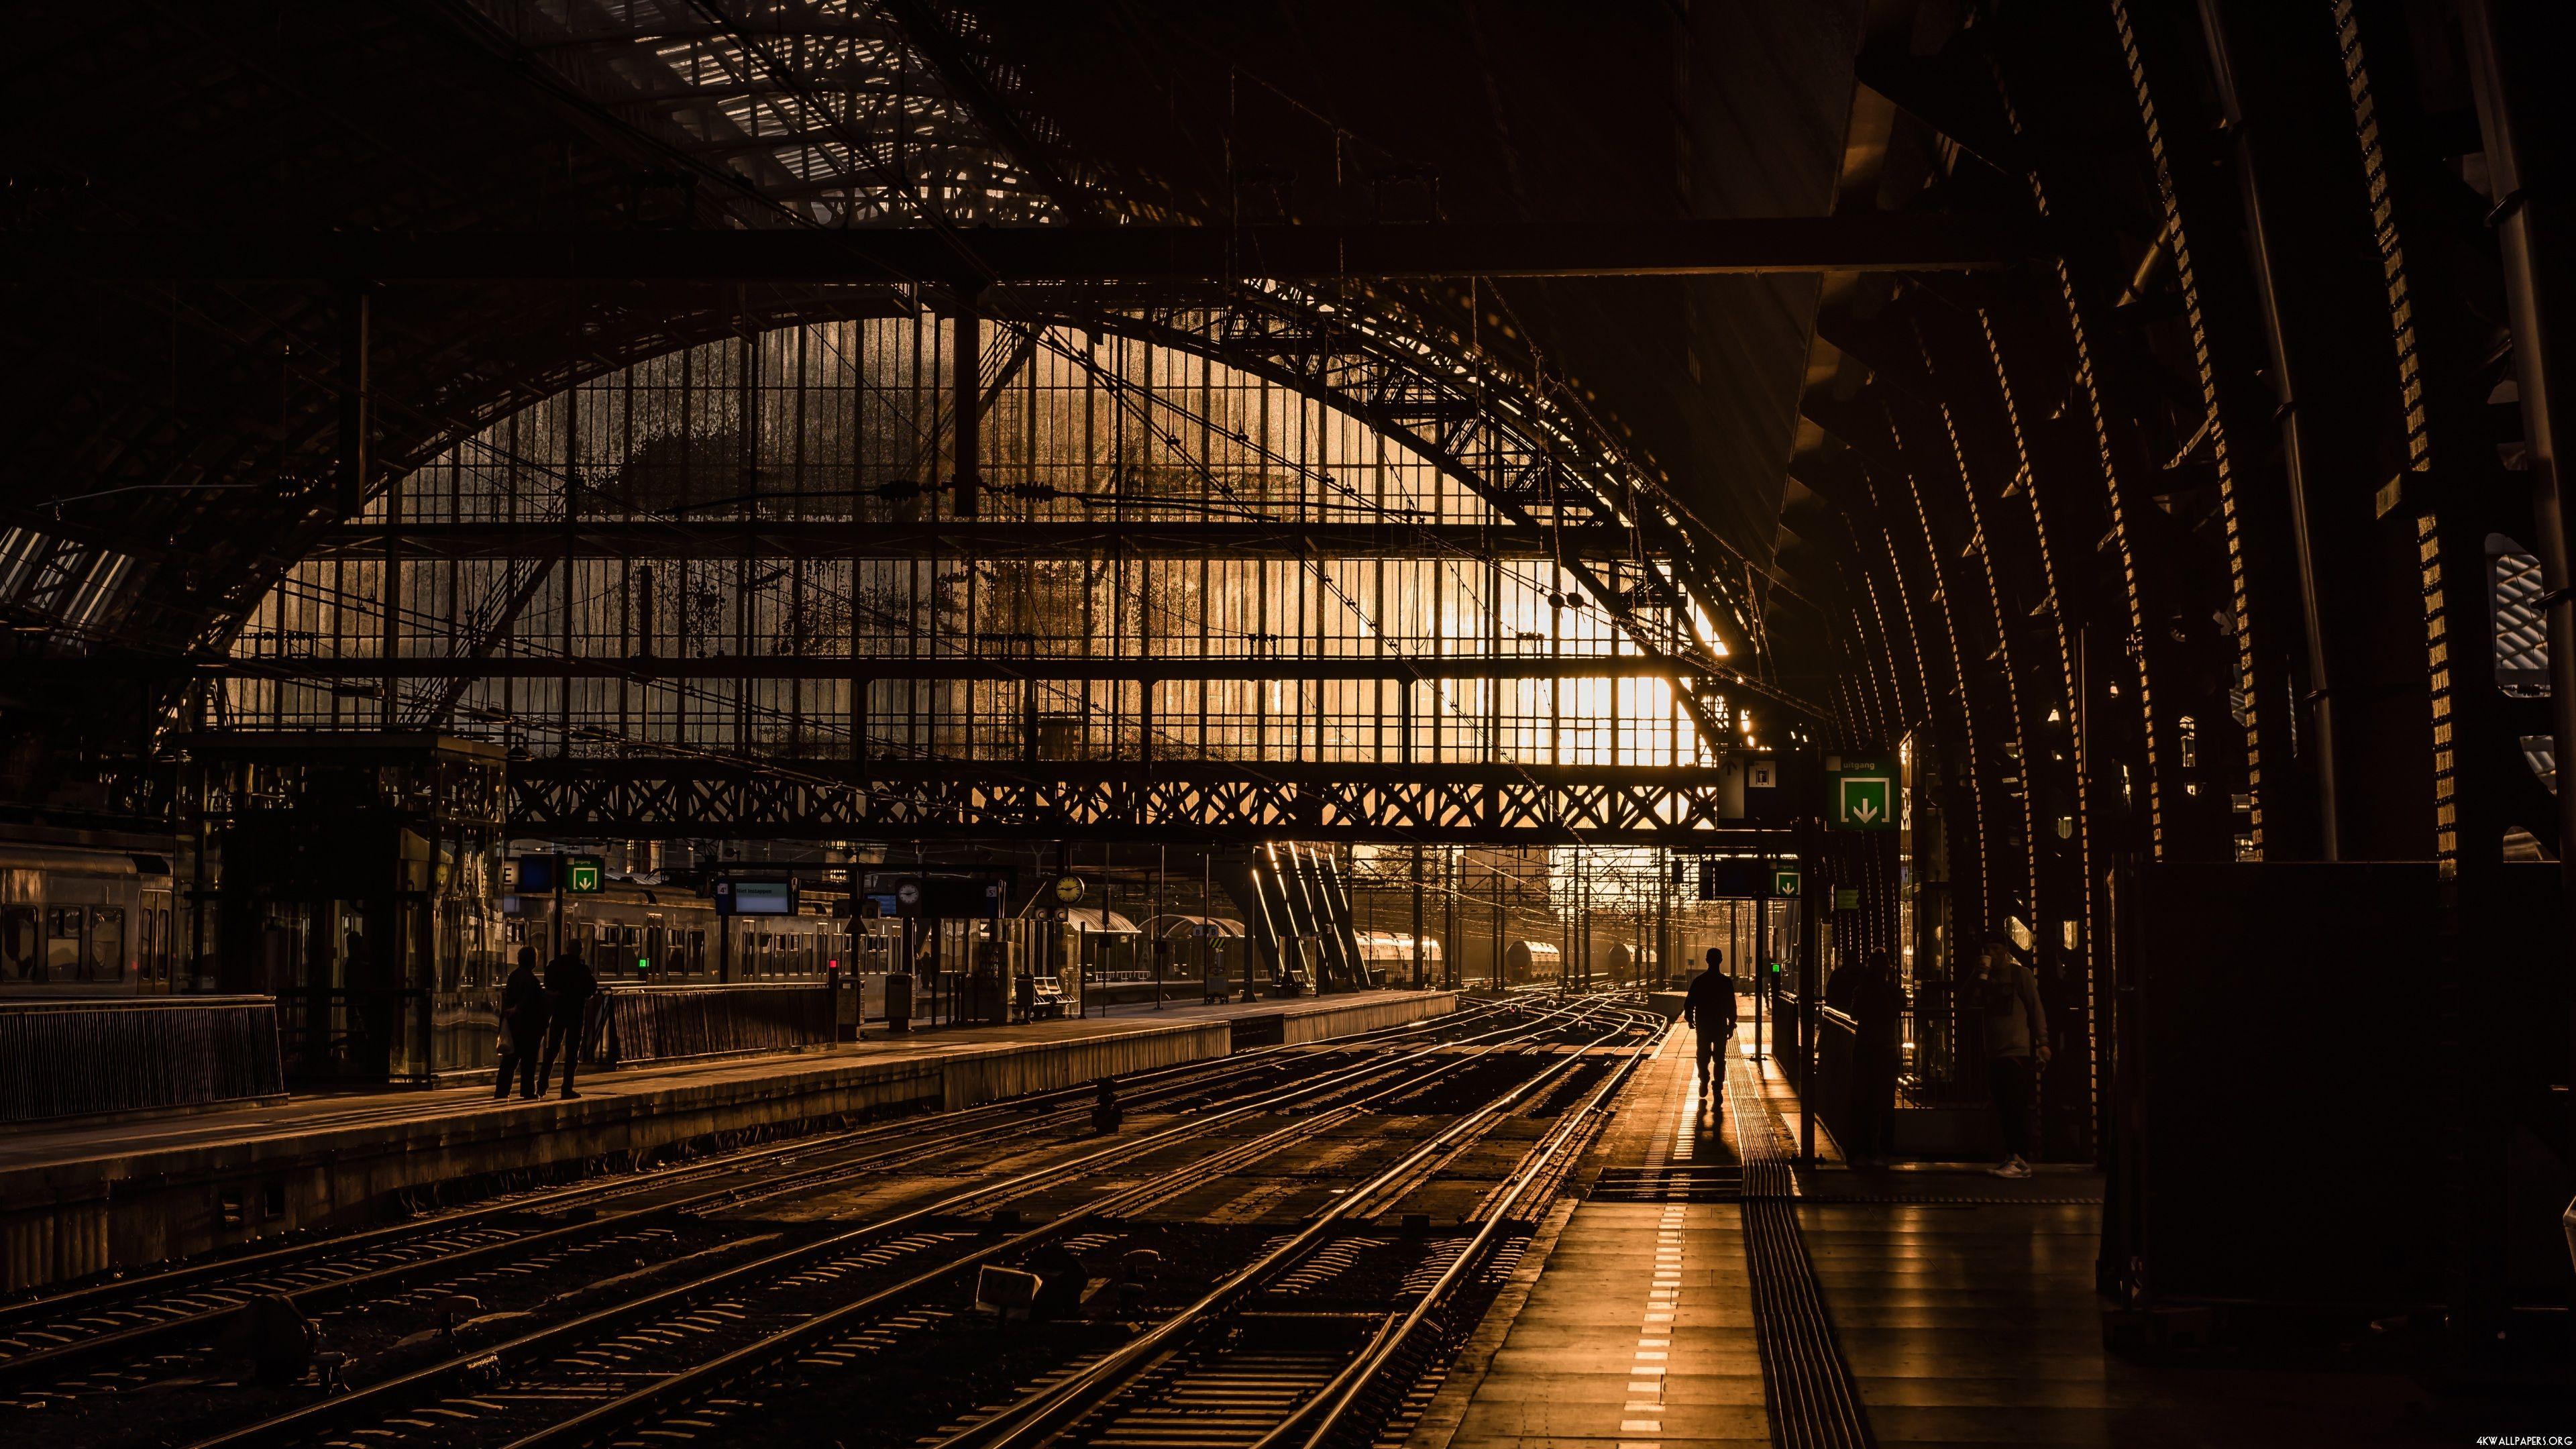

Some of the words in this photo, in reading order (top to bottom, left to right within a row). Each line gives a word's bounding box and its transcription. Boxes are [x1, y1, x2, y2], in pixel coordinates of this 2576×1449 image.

[1843, 761, 1875, 770] uitgang
[503, 868, 512, 882] E
[1038, 911, 1044, 919] C
[1057, 911, 1064, 920] C
